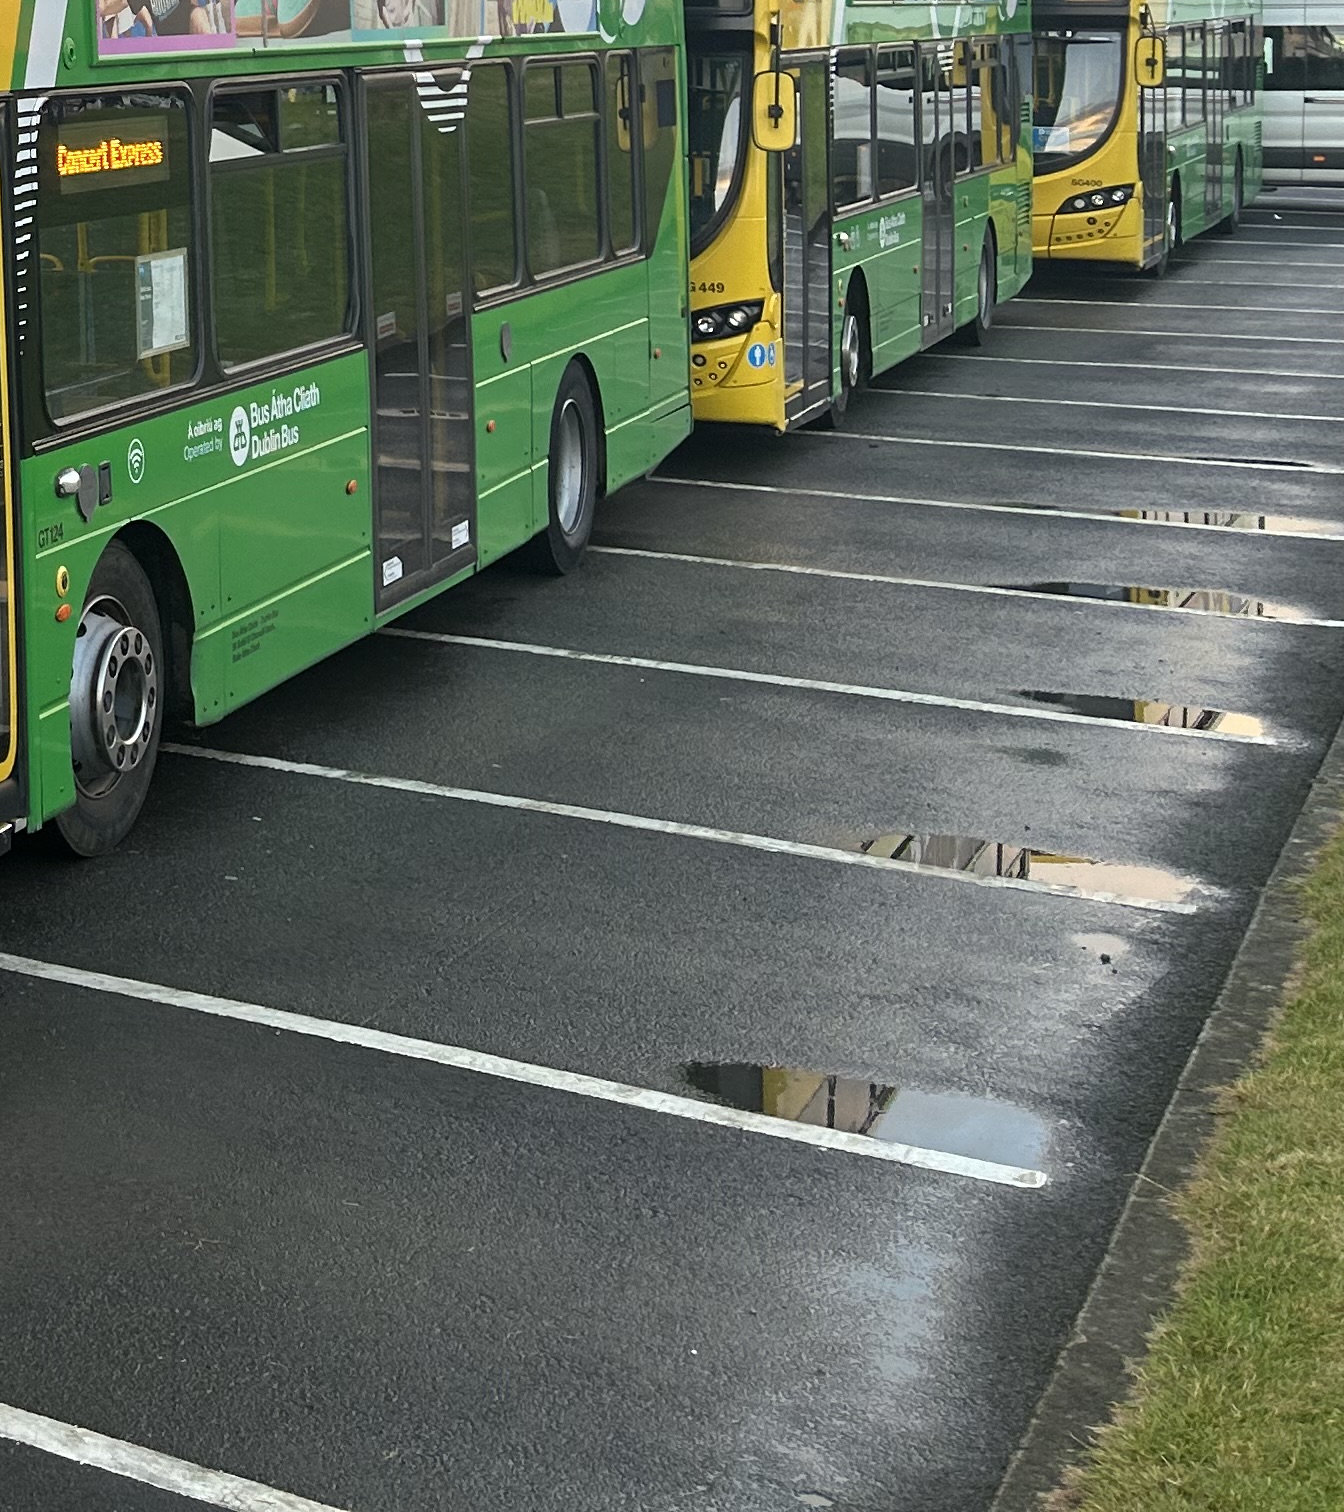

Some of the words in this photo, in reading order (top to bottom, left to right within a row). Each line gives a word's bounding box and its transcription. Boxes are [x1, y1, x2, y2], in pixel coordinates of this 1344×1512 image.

[250, 402, 269, 428] Bus
[271, 389, 293, 421] Átha
[294, 382, 320, 412] Cliath
[251, 428, 281, 459] Dublin
[282, 424, 299, 448] Bus
[38, 522, 63, 548] GT124
